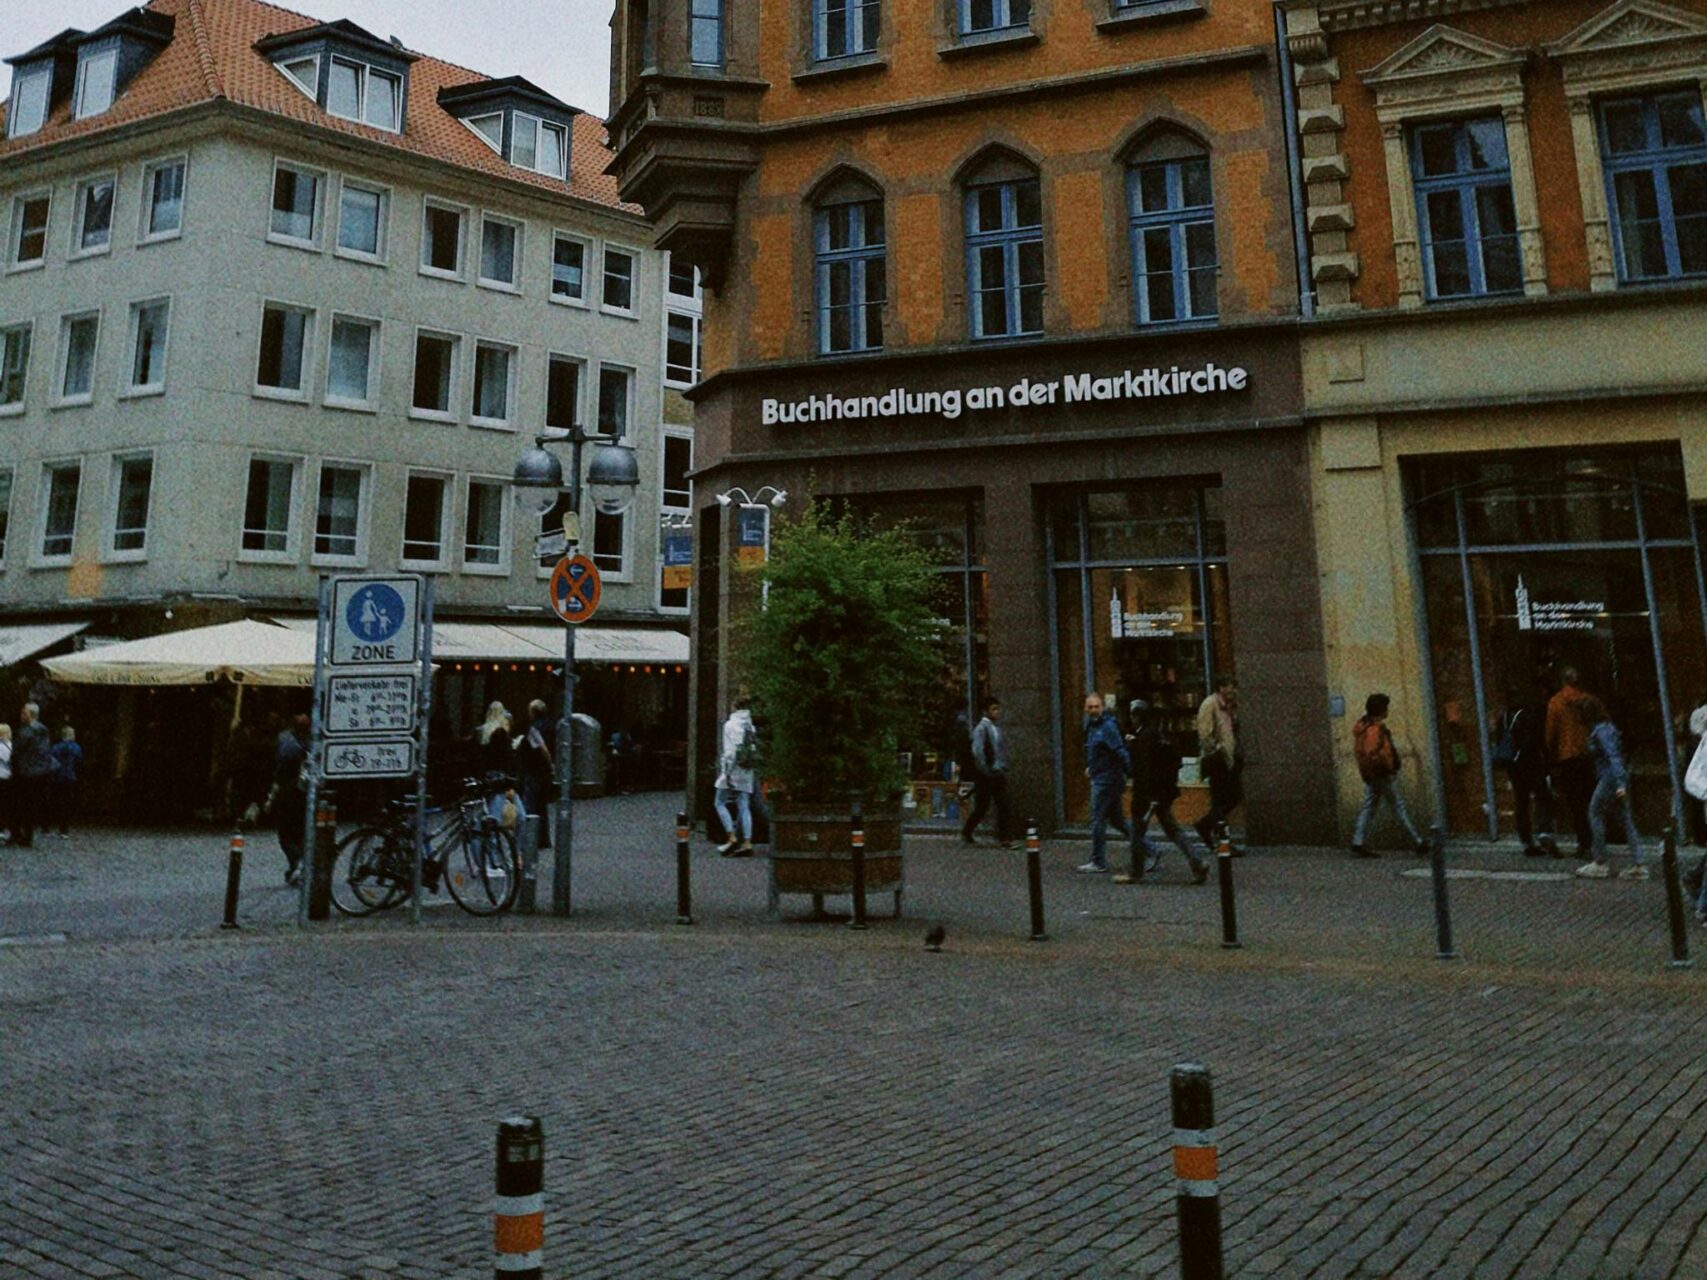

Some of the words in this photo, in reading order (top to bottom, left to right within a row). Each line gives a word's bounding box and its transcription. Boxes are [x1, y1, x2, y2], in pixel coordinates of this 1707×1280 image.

[762, 388, 962, 425] Buchhandlung
[965, 387, 1004, 409] an
[1008, 379, 1059, 406] der
[1063, 363, 1247, 403] Marktkirche
[351, 645, 396, 661] ZONE
